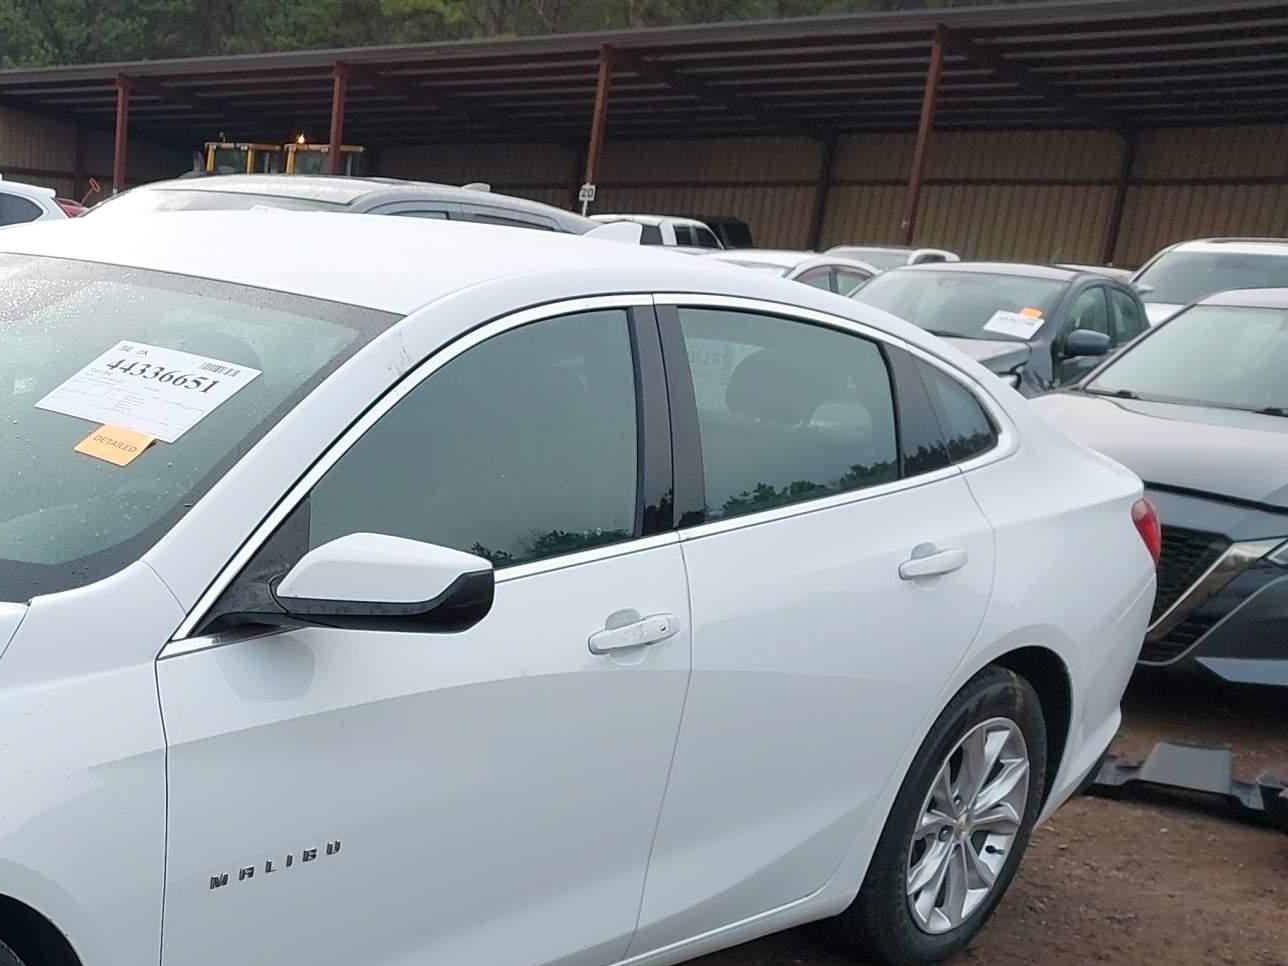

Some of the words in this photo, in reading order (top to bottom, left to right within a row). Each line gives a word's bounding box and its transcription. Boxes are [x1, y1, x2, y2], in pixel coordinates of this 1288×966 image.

[581, 187, 594, 198] 20
[110, 359, 220, 393] 44336651
[93, 433, 139, 453] DETAILED
[209, 839, 342, 890] MALIBU
